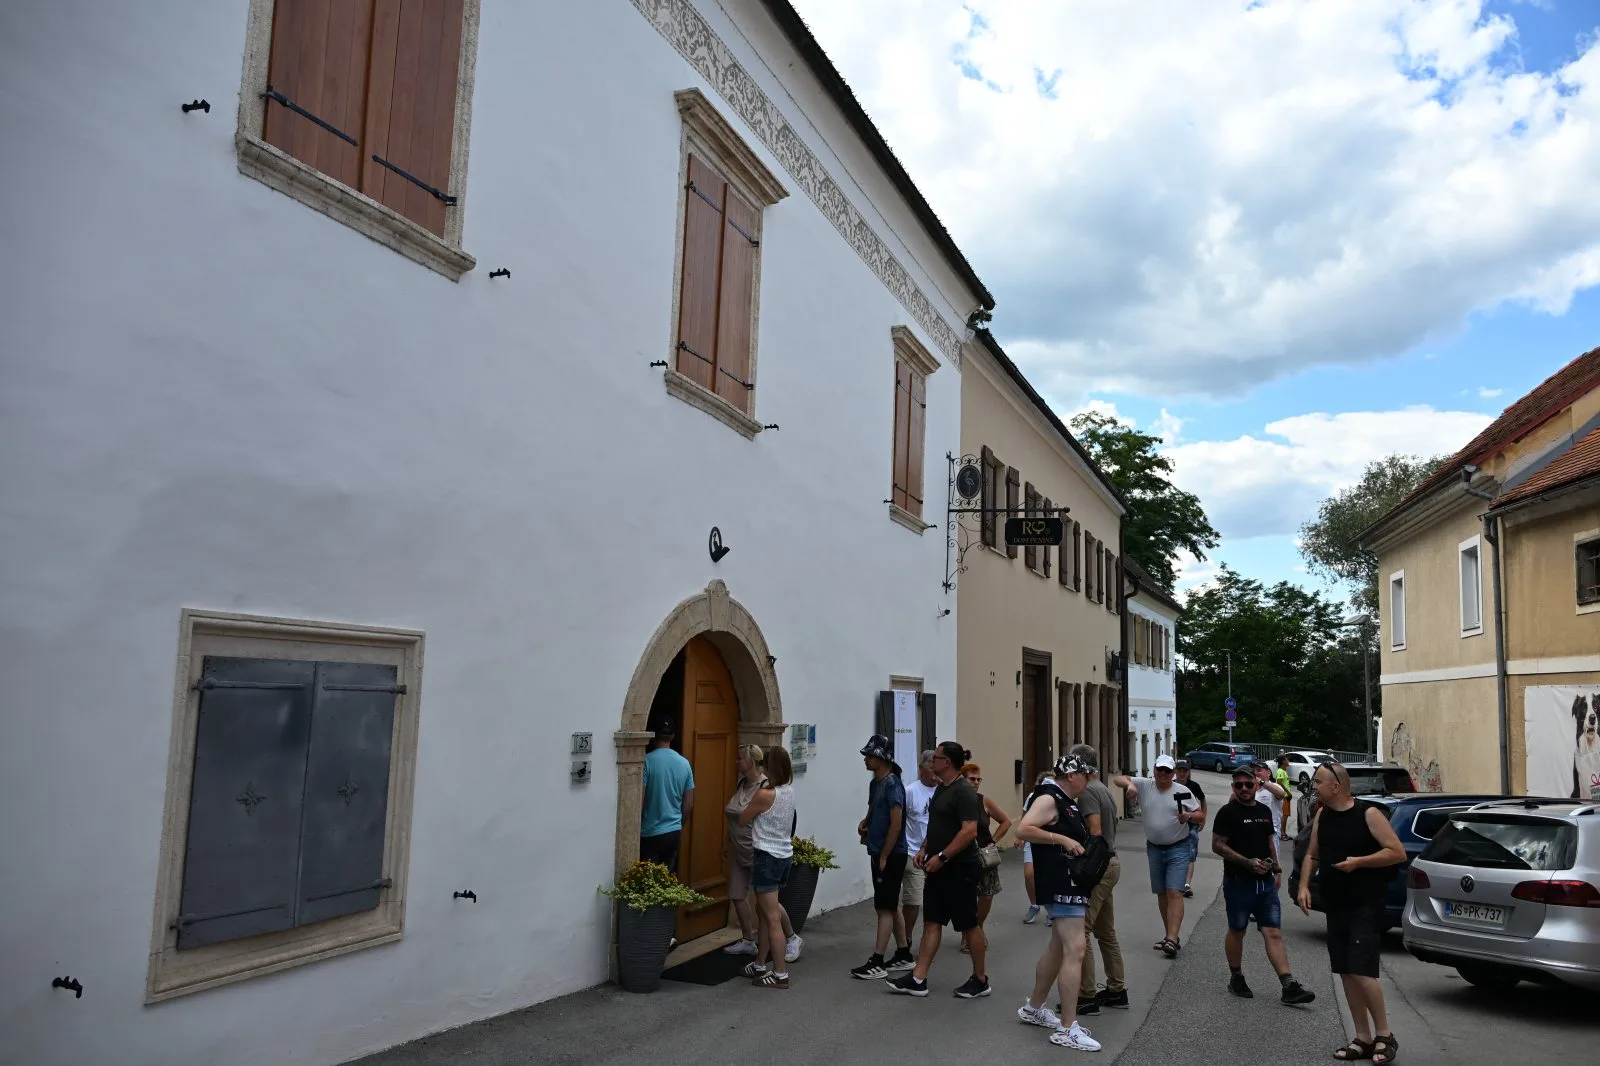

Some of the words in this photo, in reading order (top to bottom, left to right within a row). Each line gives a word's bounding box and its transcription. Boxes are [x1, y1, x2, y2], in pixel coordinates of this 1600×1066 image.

[579, 736, 589, 749] 25
[1450, 903, 1463, 916] MS
[1468, 905, 1502, 921] PK-737
